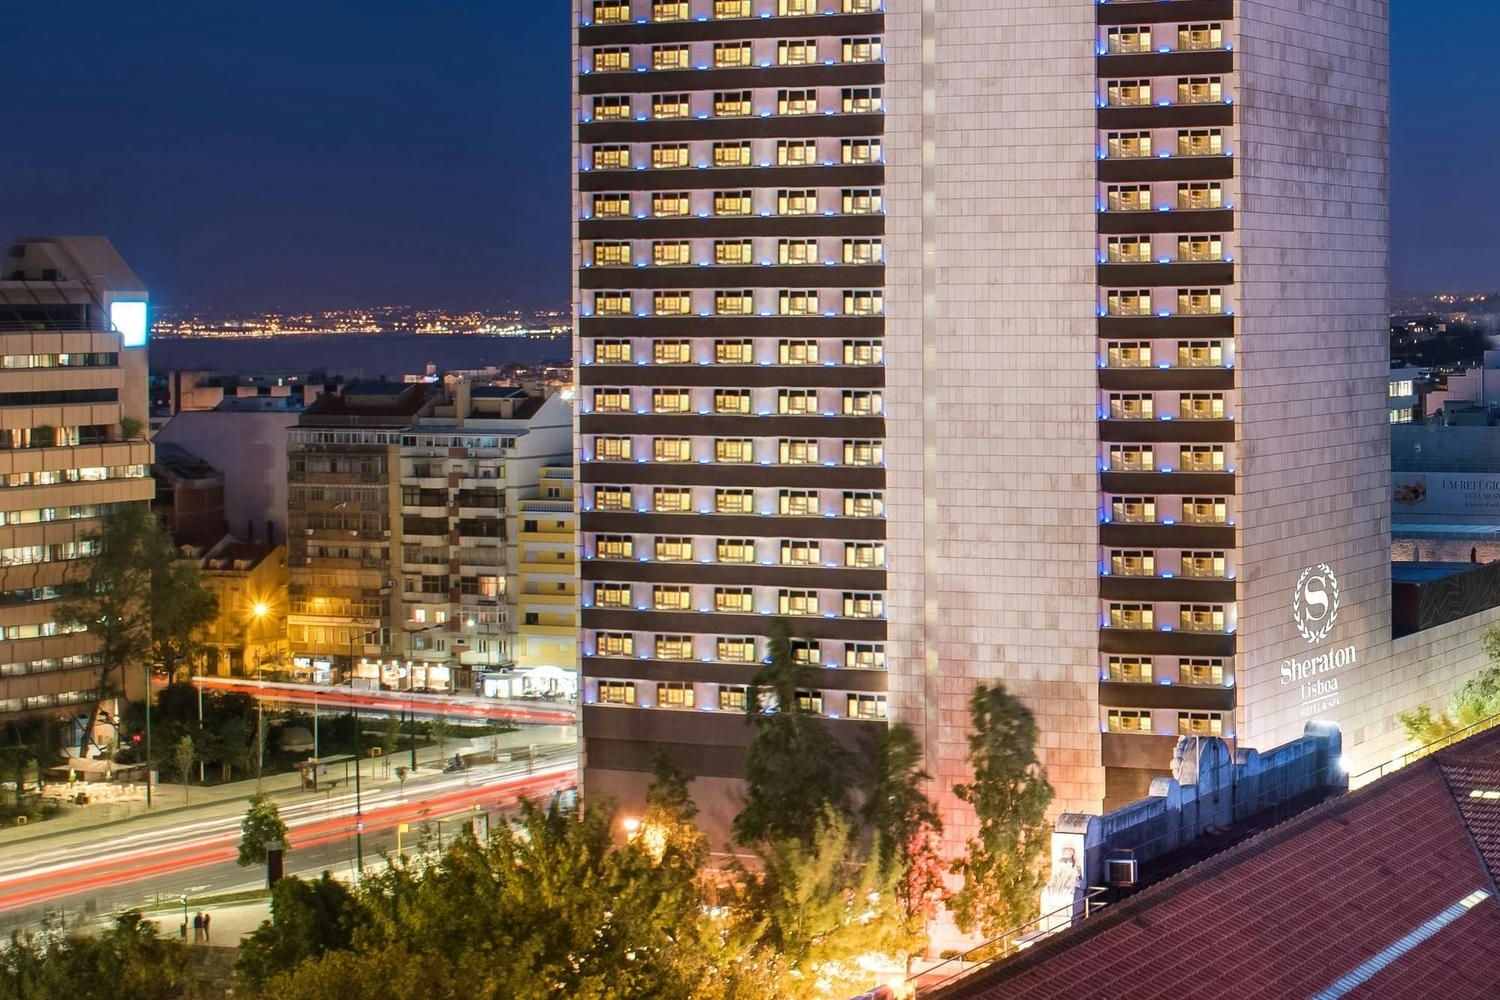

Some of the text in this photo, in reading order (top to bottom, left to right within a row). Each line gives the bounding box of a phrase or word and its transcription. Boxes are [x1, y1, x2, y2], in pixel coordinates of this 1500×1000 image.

[1304, 576, 1328, 621] S
[1280, 645, 1356, 685] Sheraton
[1301, 677, 1339, 700] Lisboa
